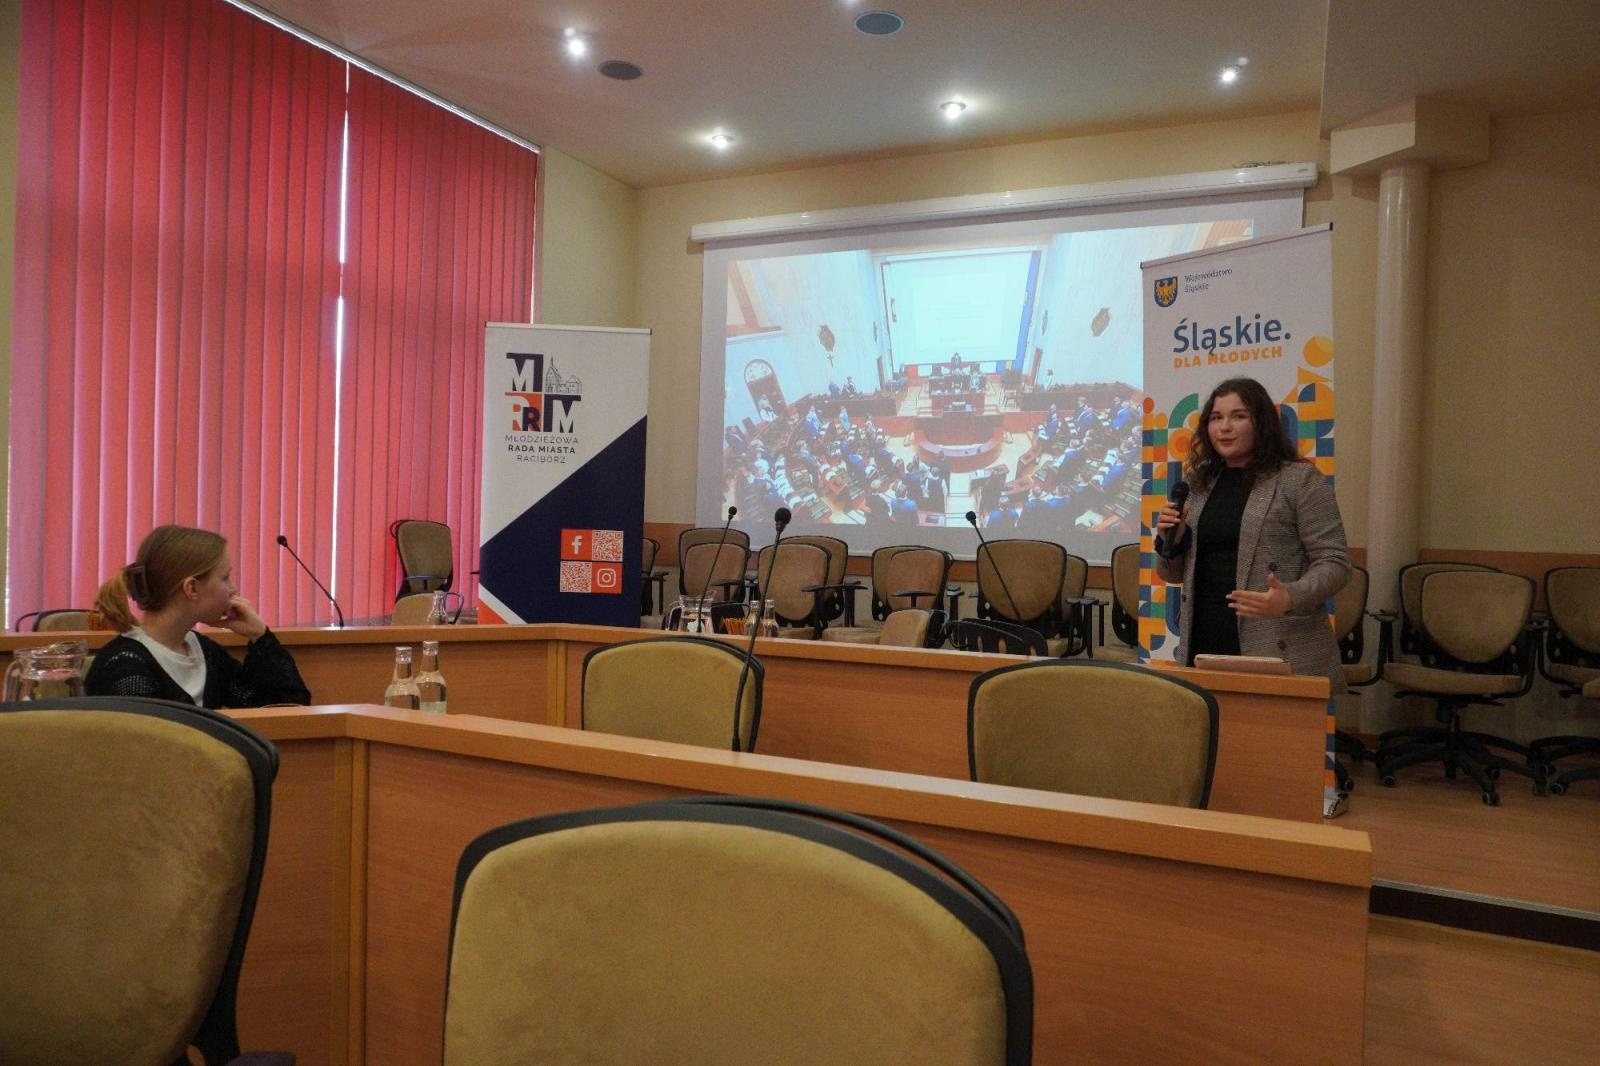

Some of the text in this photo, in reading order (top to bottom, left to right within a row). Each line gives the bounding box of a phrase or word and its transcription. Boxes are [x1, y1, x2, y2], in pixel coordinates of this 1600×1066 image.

[1173, 313, 1291, 356] Śląskie.
[1174, 346, 1283, 369] DLA MŁODYCH
[504, 434, 579, 444] MŁODZIEŻOWA
[508, 444, 576, 454] RADA MIASTA
